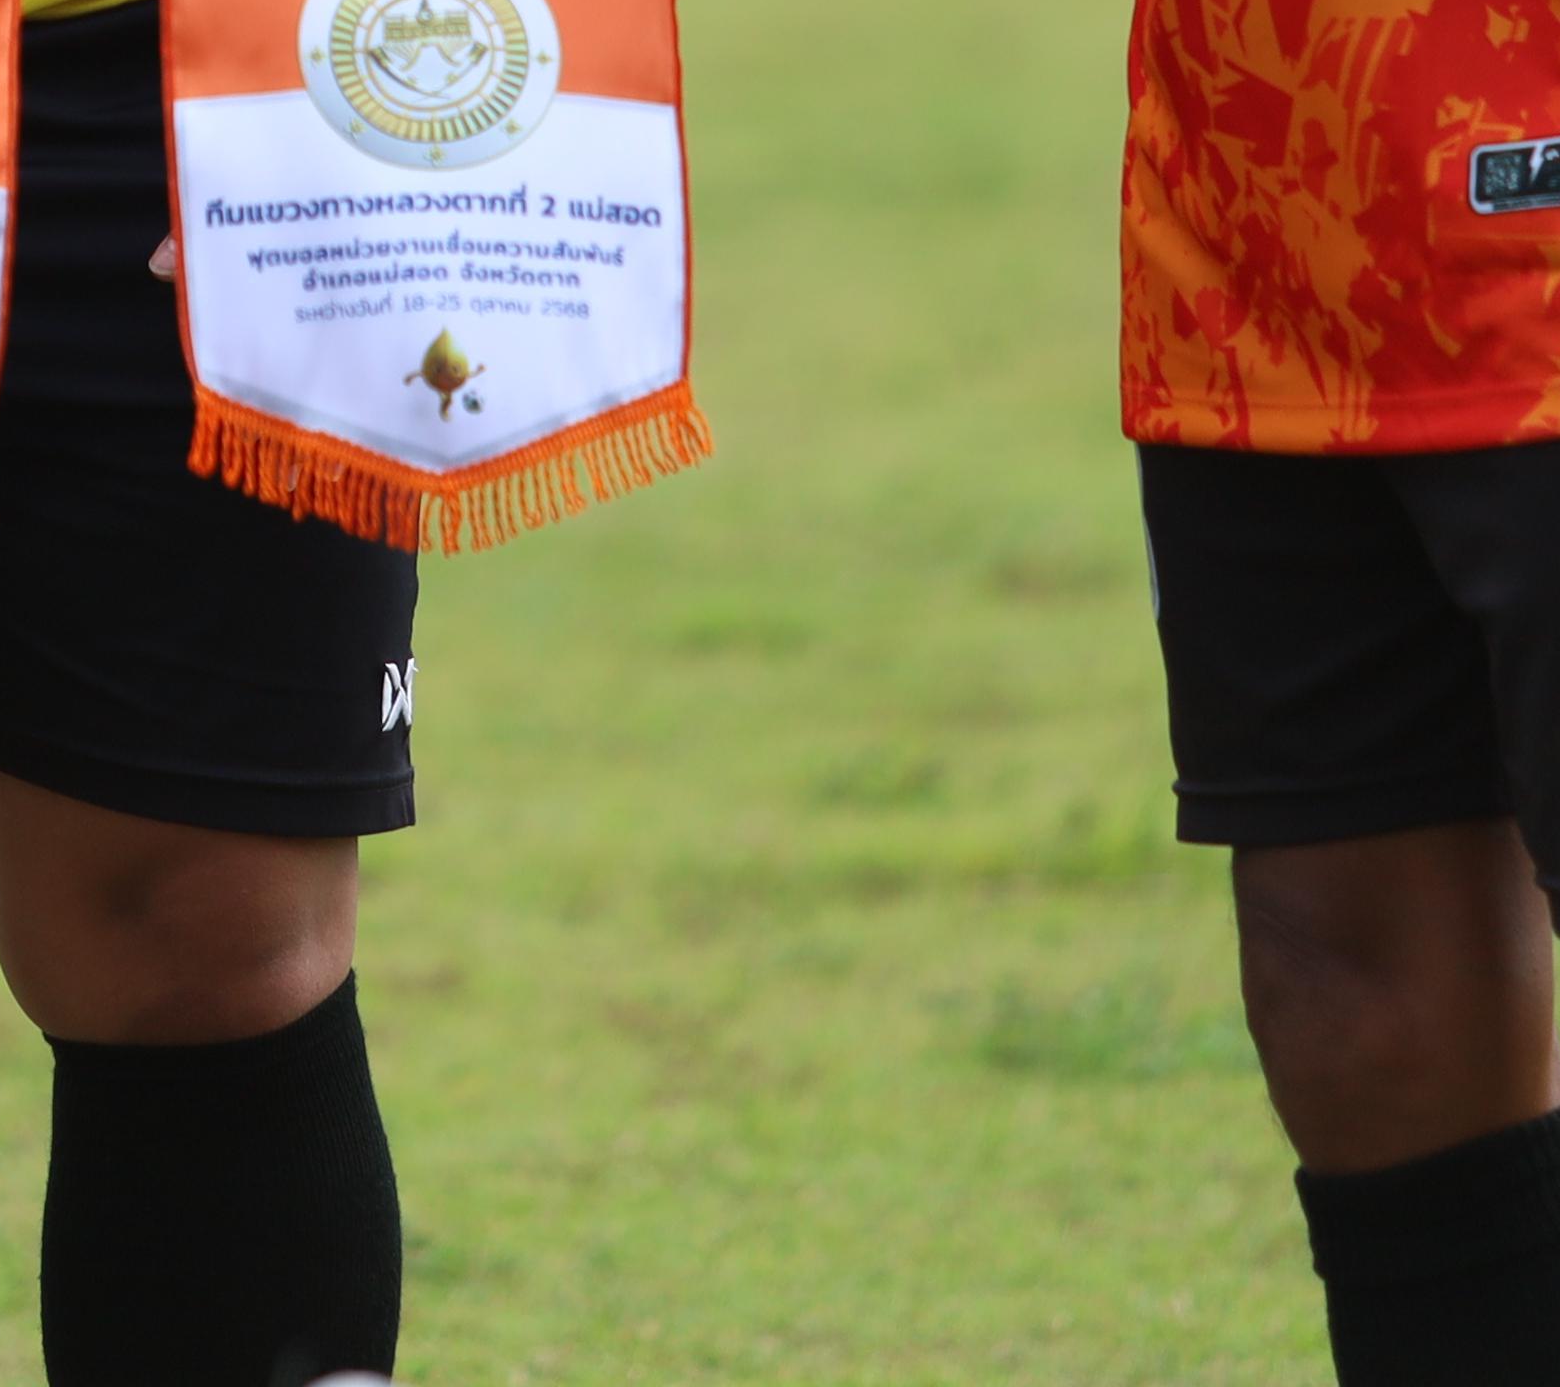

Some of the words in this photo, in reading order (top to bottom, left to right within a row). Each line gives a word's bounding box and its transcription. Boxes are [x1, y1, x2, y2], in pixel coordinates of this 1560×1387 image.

[205, 183, 528, 229] ทีมแขวงทางหลวงตากที่
[539, 195, 557, 219] 2
[567, 197, 662, 229] แม่สอด
[302, 261, 449, 293] อำเภอแม่สอด
[460, 263, 581, 289] จังหวัดตาก
[402, 293, 463, 315] 18-25
[470, 295, 533, 318] ตุลาคม
[540, 297, 591, 320] 2568
